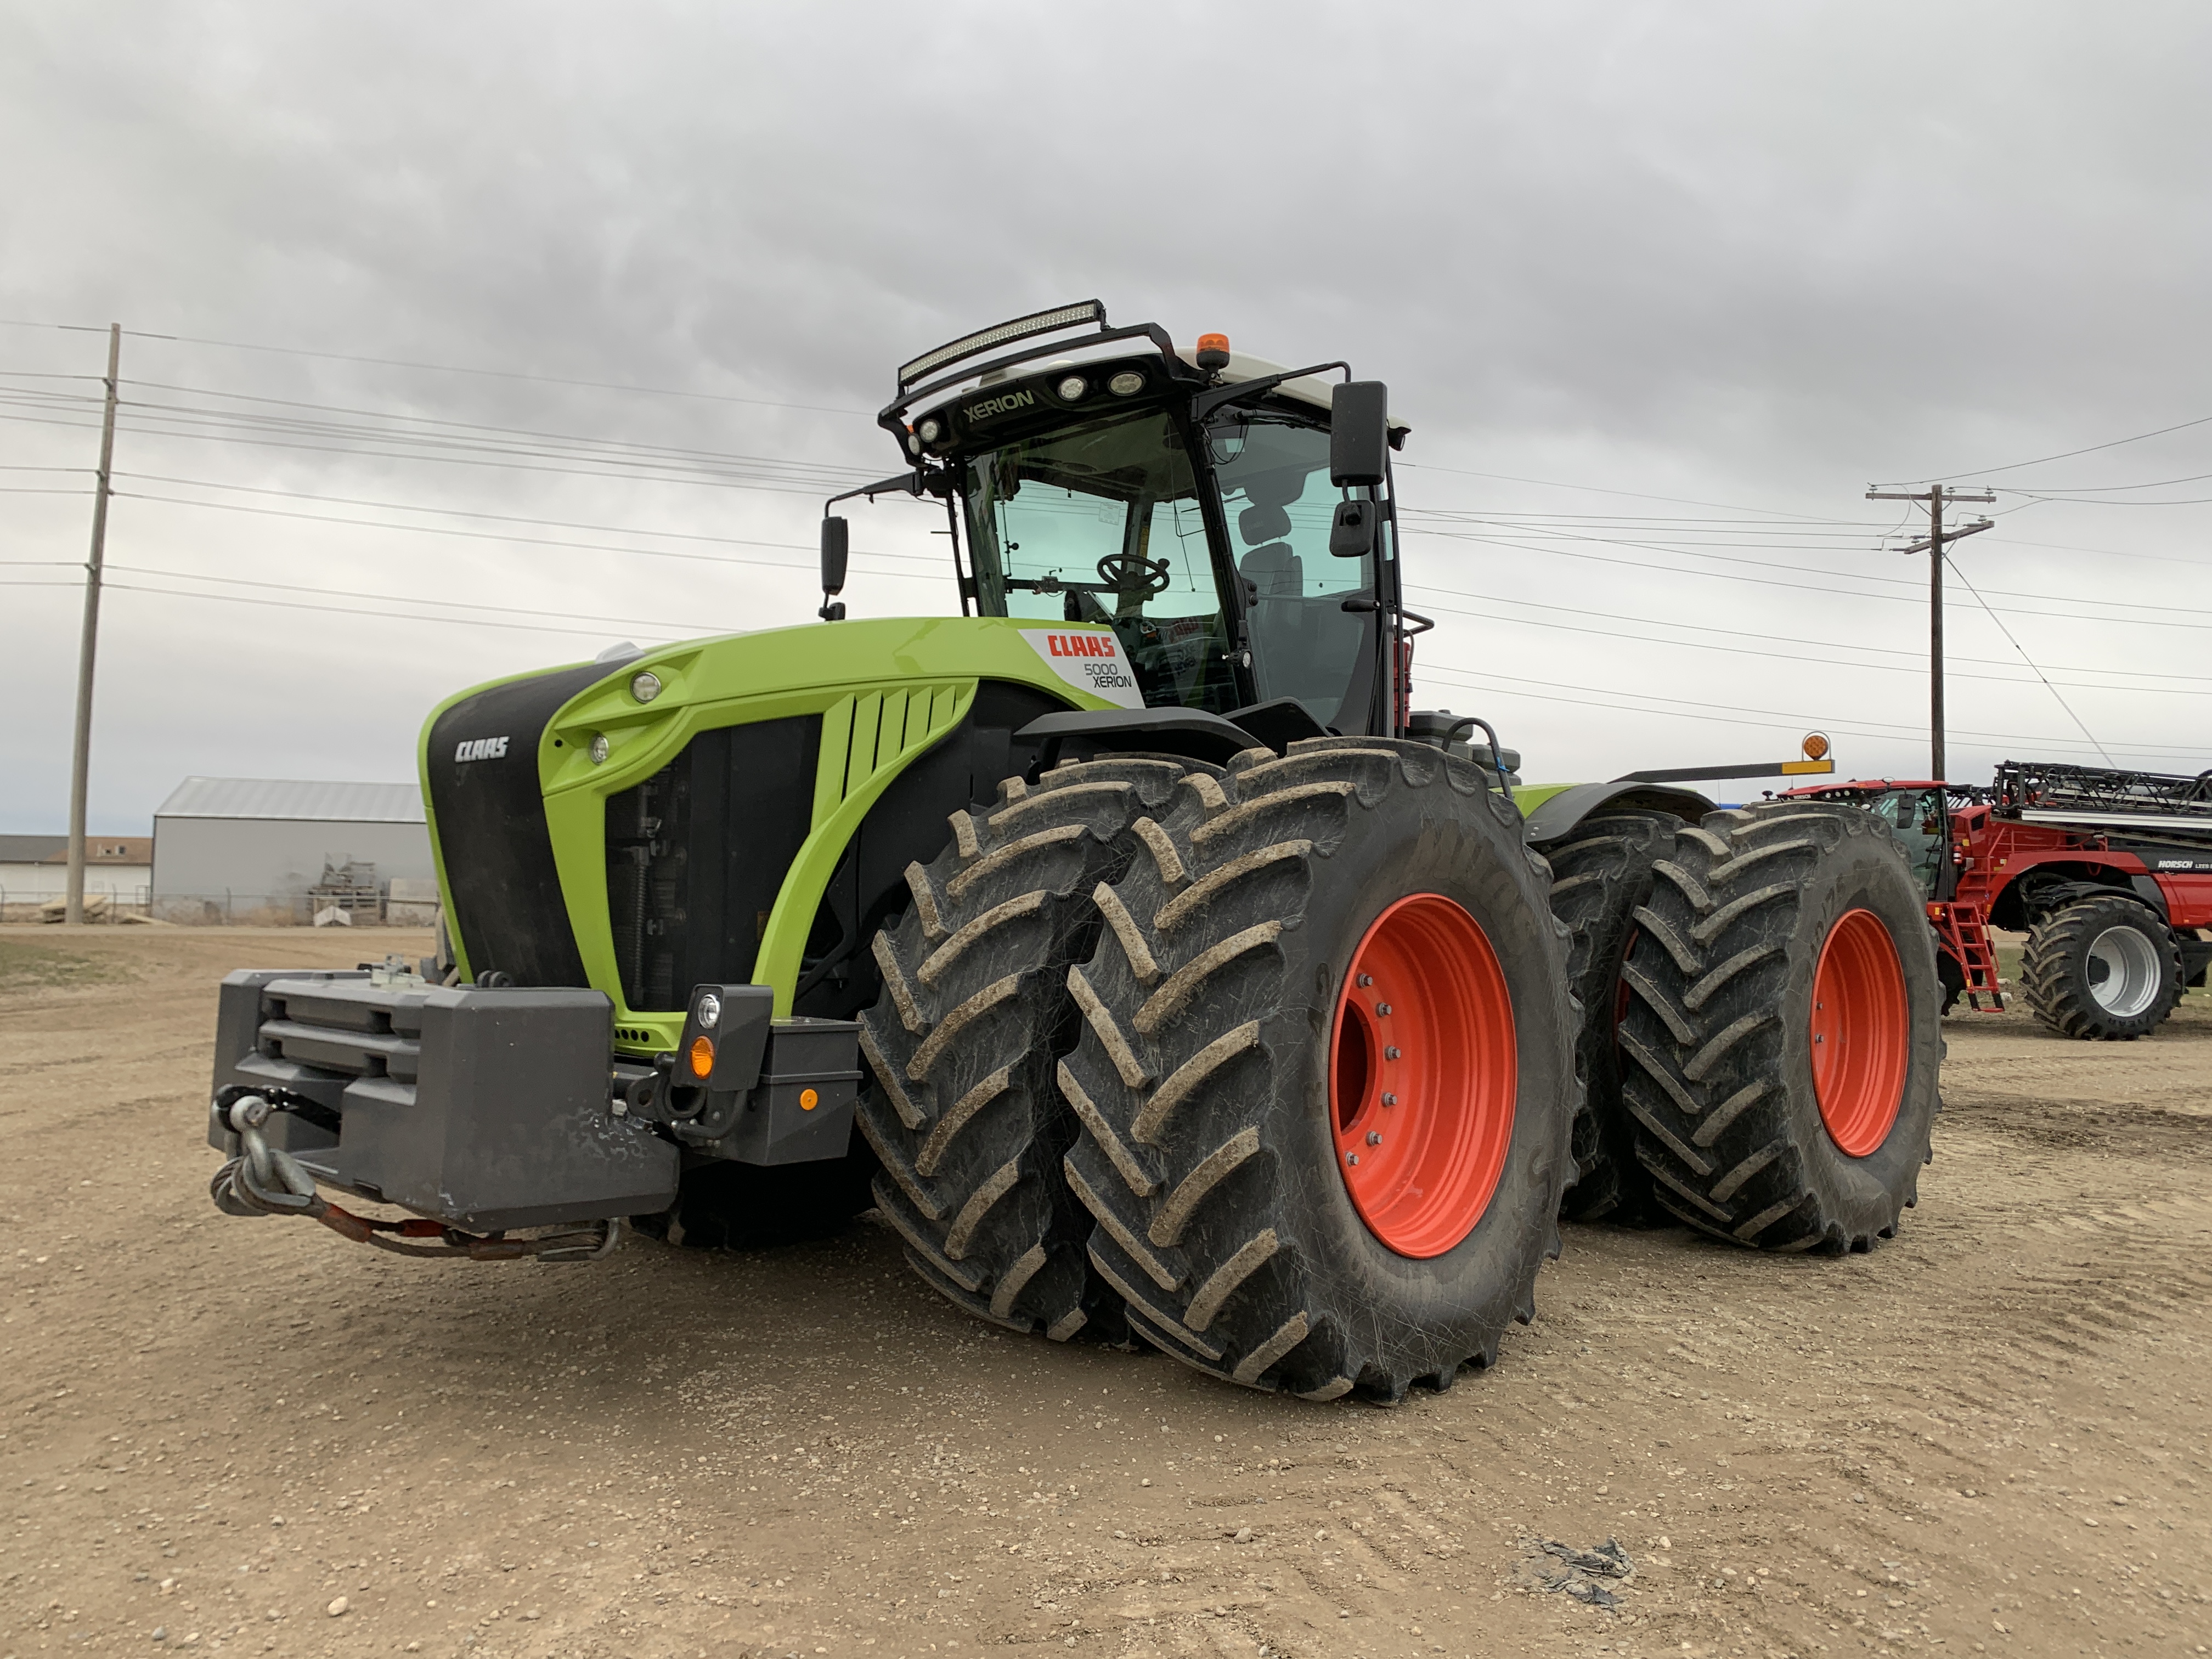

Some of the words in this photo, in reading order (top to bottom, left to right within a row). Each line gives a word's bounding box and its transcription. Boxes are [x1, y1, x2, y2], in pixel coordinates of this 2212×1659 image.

[963, 390, 1034, 423] XERION
[1047, 635, 1115, 657] CLAAS
[1084, 663, 1118, 675] 5000
[1093, 676, 1132, 688] XERION
[455, 736, 510, 763] CLAAS
[2158, 860, 2193, 868] HORSCH
